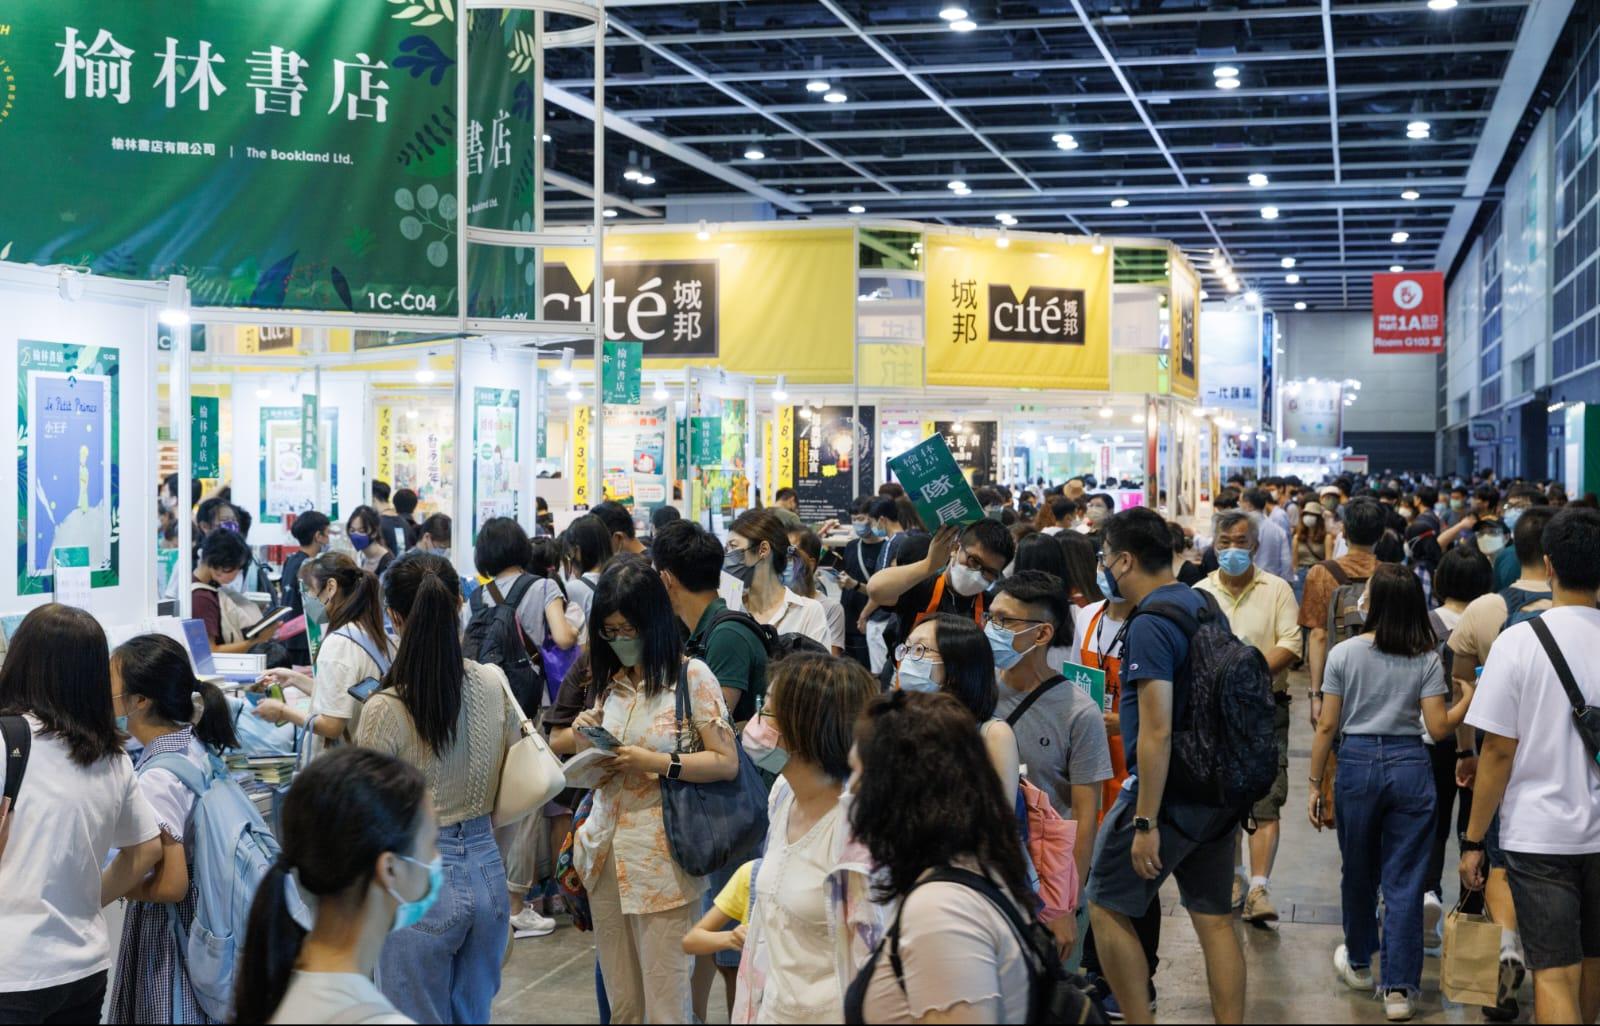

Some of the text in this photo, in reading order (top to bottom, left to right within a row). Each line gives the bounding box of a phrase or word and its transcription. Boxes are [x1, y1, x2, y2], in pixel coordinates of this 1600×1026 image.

[53, 26, 390, 123] 榆林書店
[111, 137, 216, 156] 榆林書店有限公司
[246, 147, 354, 165] The Bookland Ltd.
[367, 292, 437, 311] 1C-C04
[673, 279, 702, 342] 城邦
[951, 279, 977, 344] 城邦
[993, 296, 1062, 334] cité
[1063, 299, 1079, 336] 城邦
[1398, 315, 1421, 330] 1A
[616, 347, 627, 392] 榆林書店
[920, 474, 968, 526] 隊尾
